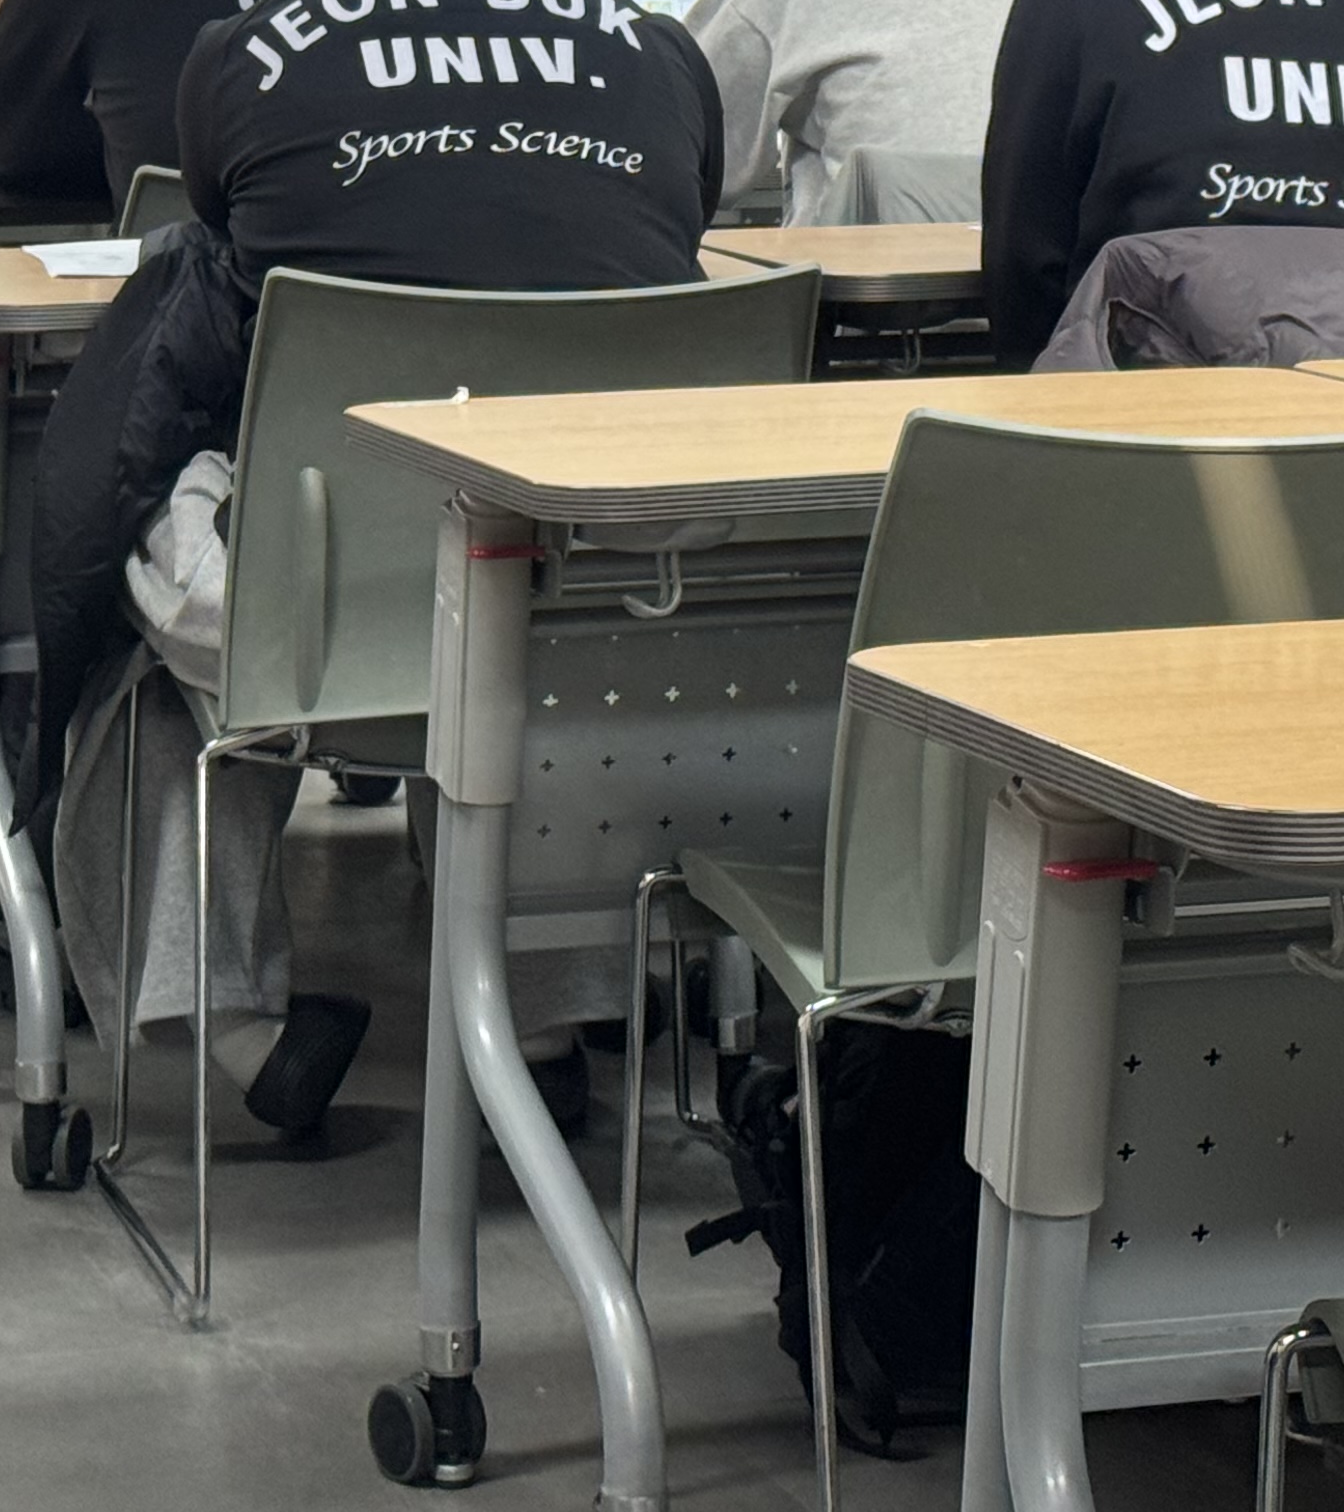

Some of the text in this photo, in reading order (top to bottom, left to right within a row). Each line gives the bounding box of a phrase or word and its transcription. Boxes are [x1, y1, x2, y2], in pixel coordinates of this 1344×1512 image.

[359, 36, 607, 89] UNIV.
[332, 121, 644, 187] Sports Science
[1199, 162, 1329, 219] Sports
